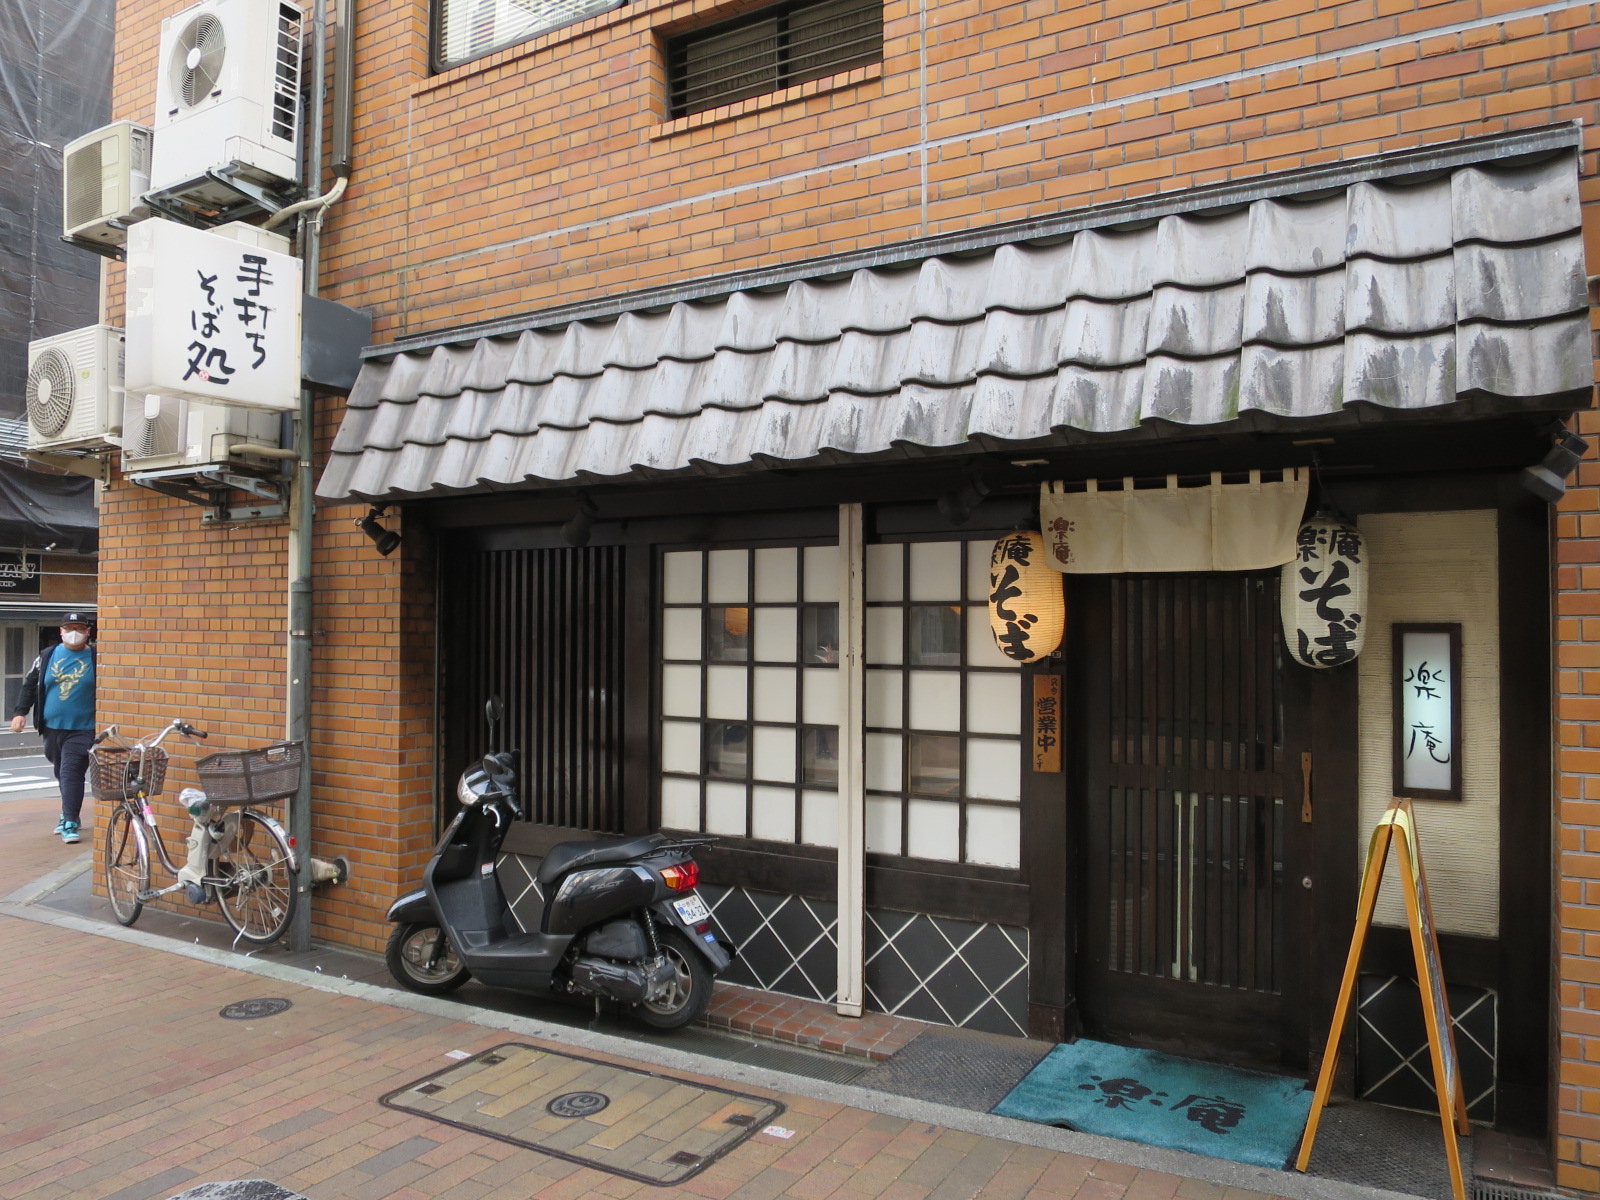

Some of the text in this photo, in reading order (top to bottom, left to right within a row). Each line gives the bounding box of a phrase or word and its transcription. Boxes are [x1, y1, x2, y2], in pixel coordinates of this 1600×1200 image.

[182, 270, 236, 385] そば処
[233, 253, 276, 370] 手打ち
[1047, 517, 1076, 564] 楽庵
[990, 564, 1039, 661] そば
[1296, 560, 1362, 666] そば
[1037, 697, 1057, 753] 営業中
[1404, 660, 1450, 764] 楽庵
[1078, 1075, 1247, 1135] 楽庵
